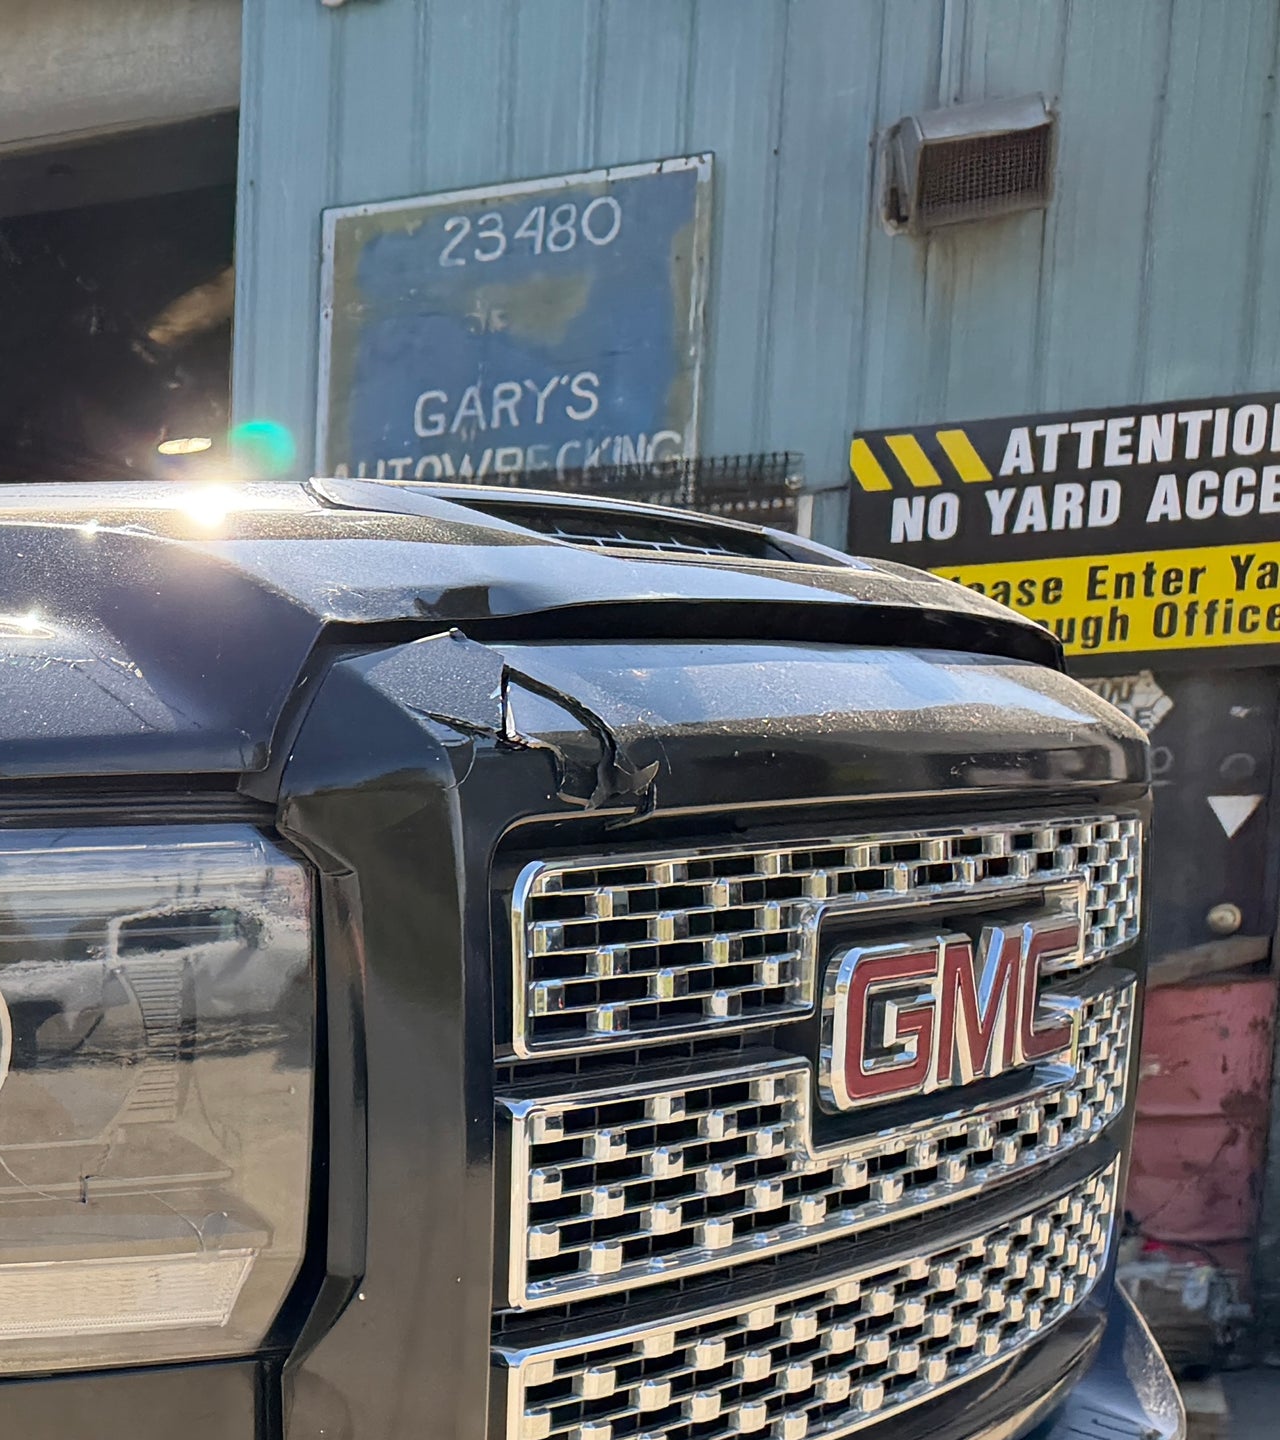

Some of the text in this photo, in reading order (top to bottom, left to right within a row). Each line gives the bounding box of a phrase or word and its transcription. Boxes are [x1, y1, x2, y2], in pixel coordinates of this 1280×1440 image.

[439, 196, 623, 268] 23480
[414, 371, 601, 438] GARY'S
[890, 493, 960, 544] NO
[985, 479, 1122, 536] YARD
[1087, 561, 1207, 603] Enter
[831, 922, 1079, 1110] GMC
